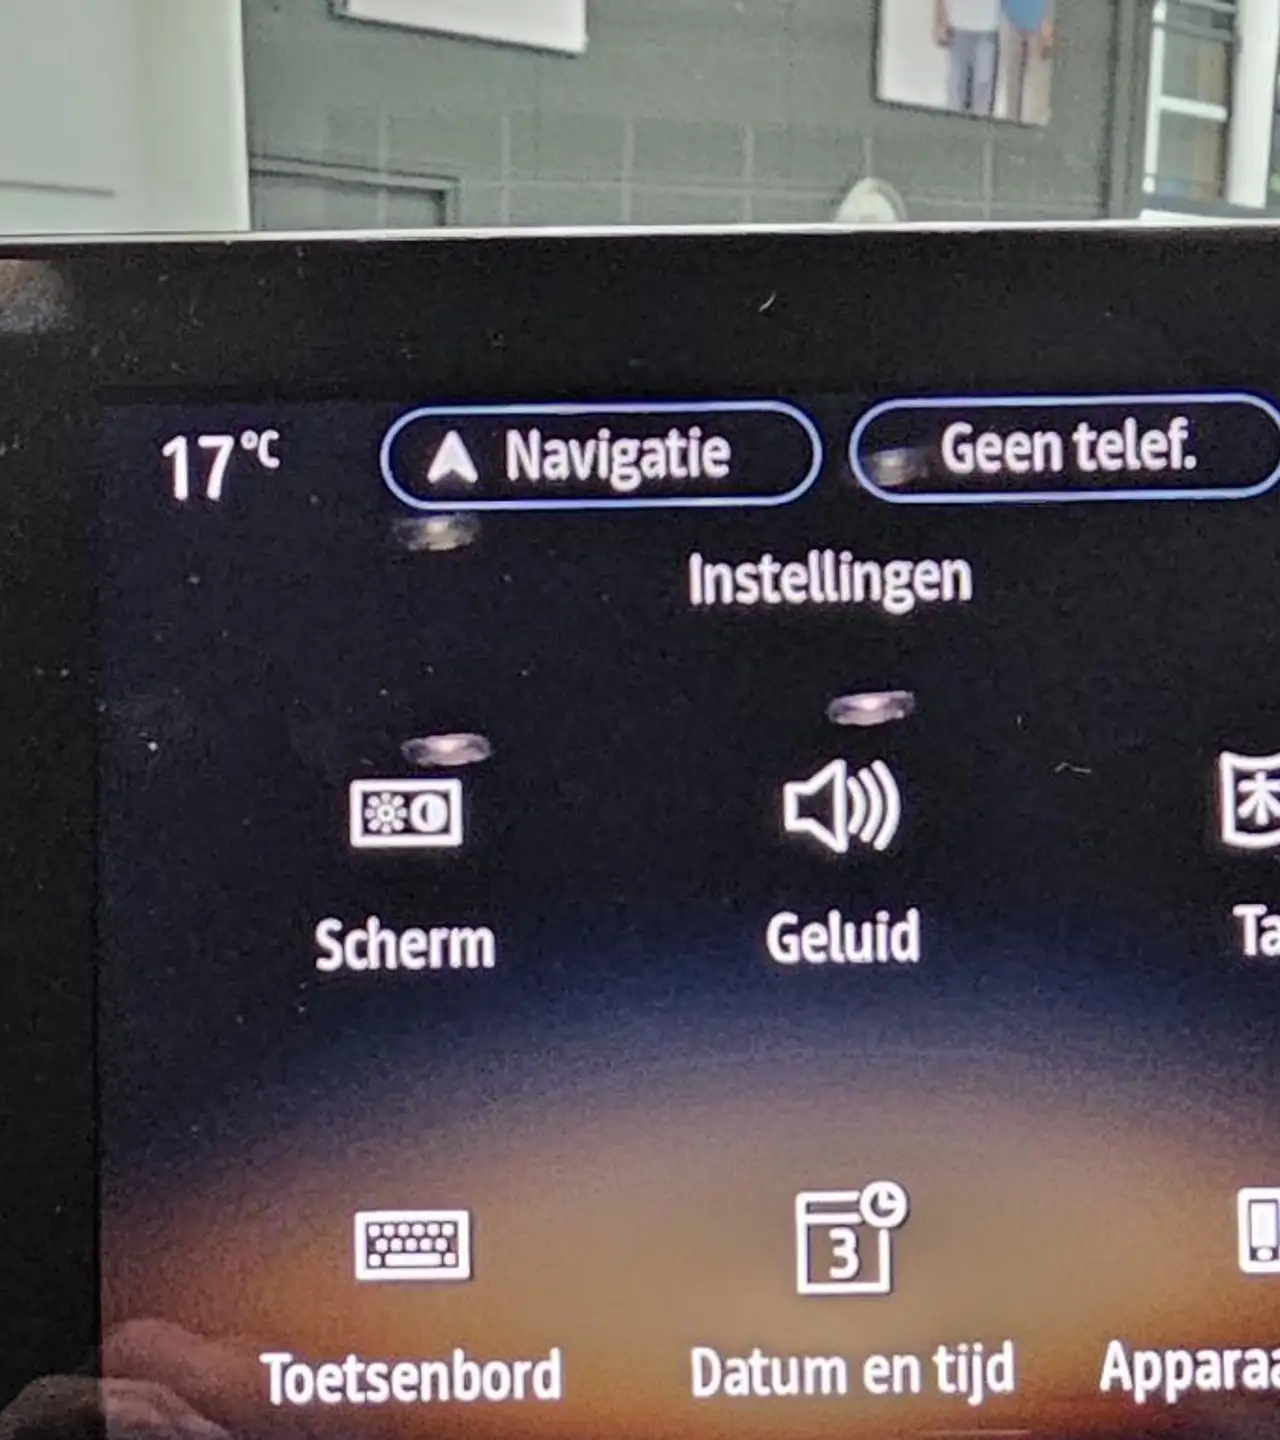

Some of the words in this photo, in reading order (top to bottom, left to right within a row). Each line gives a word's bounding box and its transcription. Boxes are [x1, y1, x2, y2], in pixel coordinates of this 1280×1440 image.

[505, 427, 732, 492] Navigatie
[941, 422, 1063, 474] Geen
[1072, 416, 1198, 472] telef.
[689, 549, 973, 614] Instellingen
[315, 915, 496, 972] Scherm
[766, 908, 921, 965] Geluid
[259, 1347, 562, 1405] Toetsenbord
[691, 1347, 848, 1397] Datum
[863, 1355, 921, 1394] en
[932, 1340, 1015, 1406] tijd
